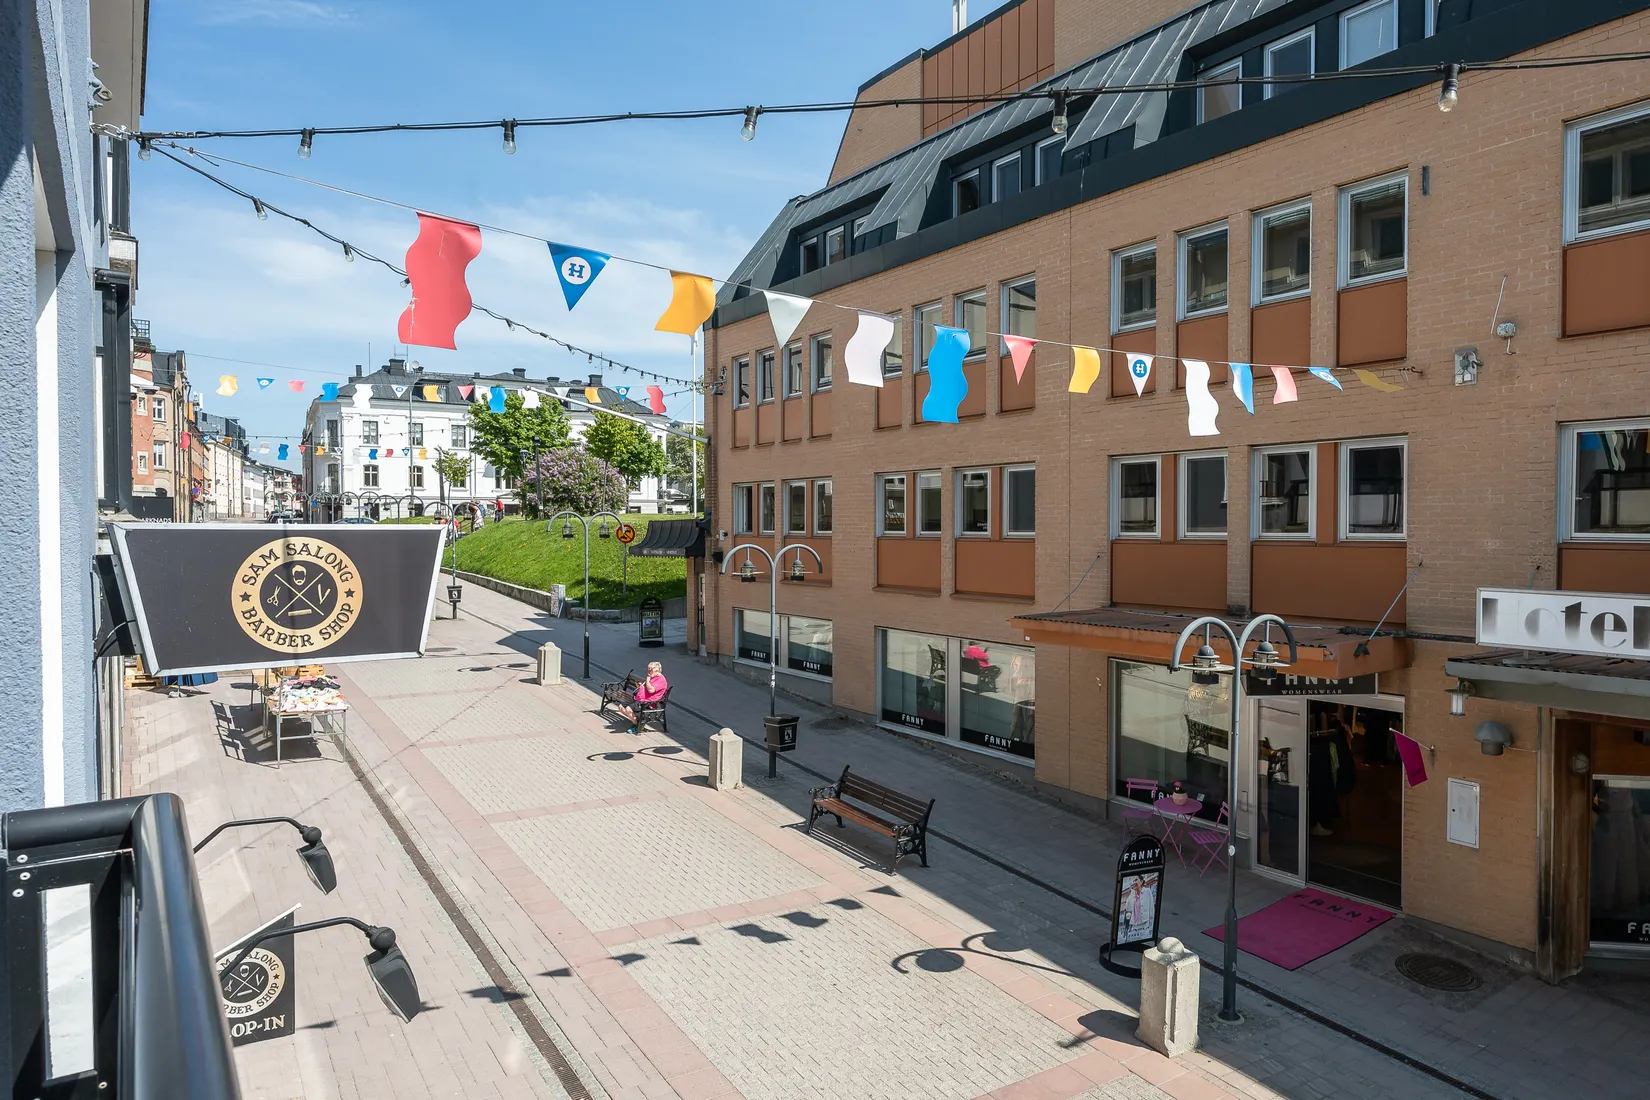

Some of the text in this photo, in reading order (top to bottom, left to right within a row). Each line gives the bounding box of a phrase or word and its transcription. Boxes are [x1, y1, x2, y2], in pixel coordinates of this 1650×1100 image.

[241, 542, 354, 586] SAM SALONG
[241, 602, 354, 647] BARBER SHOP
[751, 650, 766, 659] FANNY
[803, 661, 820, 671] FANNY
[901, 713, 925, 725] FANNY
[984, 734, 1012, 748] FANNY
[1123, 848, 1160, 862] FANNY
[1293, 894, 1377, 923] FANNY
[245, 951, 280, 972] ALONG
[256, 982, 280, 1008] SHOP
[229, 1014, 286, 1038] OP-IN
